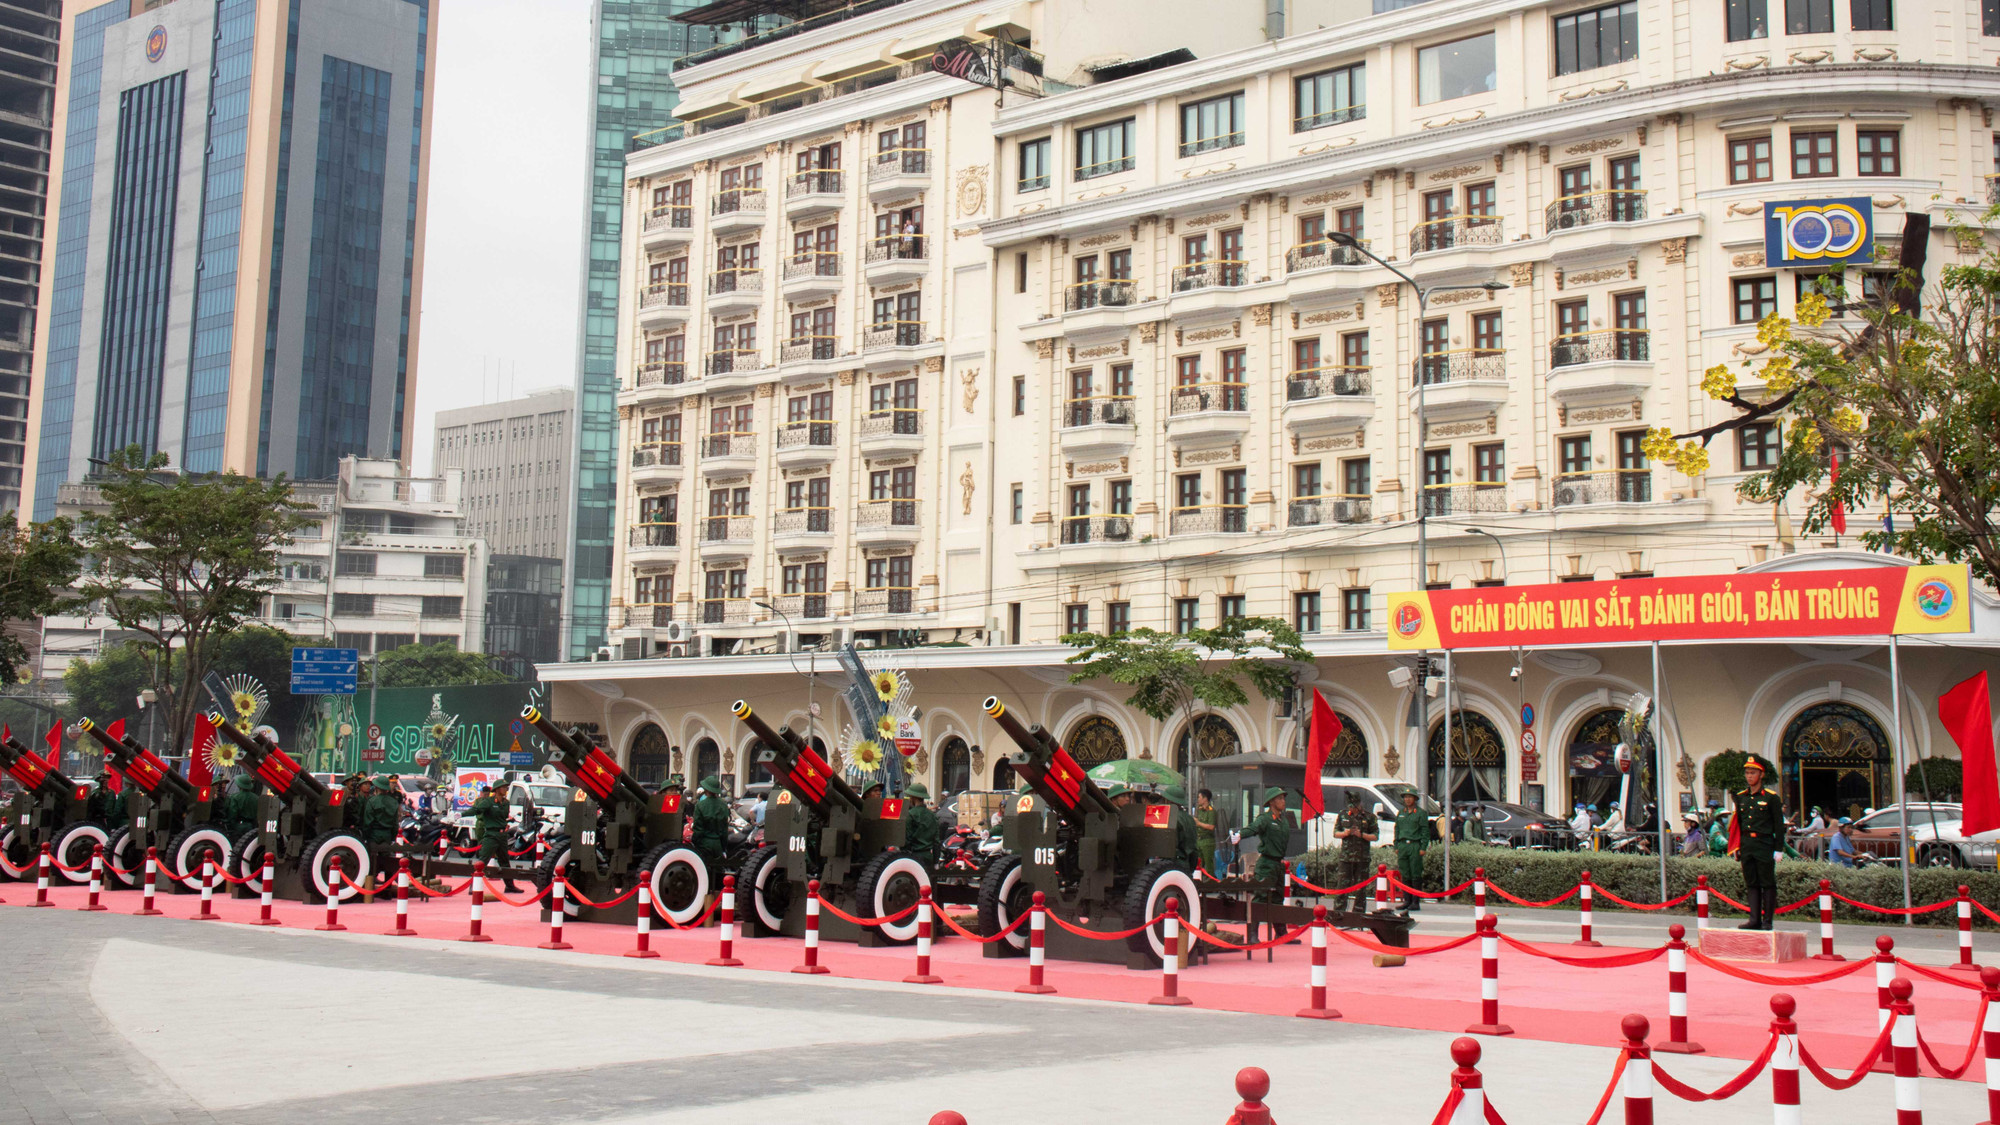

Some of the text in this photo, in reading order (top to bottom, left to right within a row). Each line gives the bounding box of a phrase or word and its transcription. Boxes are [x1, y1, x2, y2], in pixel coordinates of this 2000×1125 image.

[1772, 203, 1867, 261] 100
[1450, 598, 1499, 634] CHÂN
[1504, 592, 1555, 631] ĐỒNG
[1559, 598, 1589, 630] VAI
[1595, 586, 1635, 630] SẮT,
[1639, 588, 1695, 626] ĐÁNH
[1701, 582, 1749, 626] GIỎI,
[1755, 579, 1800, 622] BẮN
[1805, 581, 1880, 619] TRÚNG
[900, 722, 909, 730] HD
[900, 730, 915, 738] Bank
[21, 813, 30, 825] 010
[136, 816, 147, 828] 011
[266, 820, 278, 833] 012
[581, 830, 596, 846] 013
[789, 836, 806, 852] 014
[1034, 847, 1055, 865] 015
